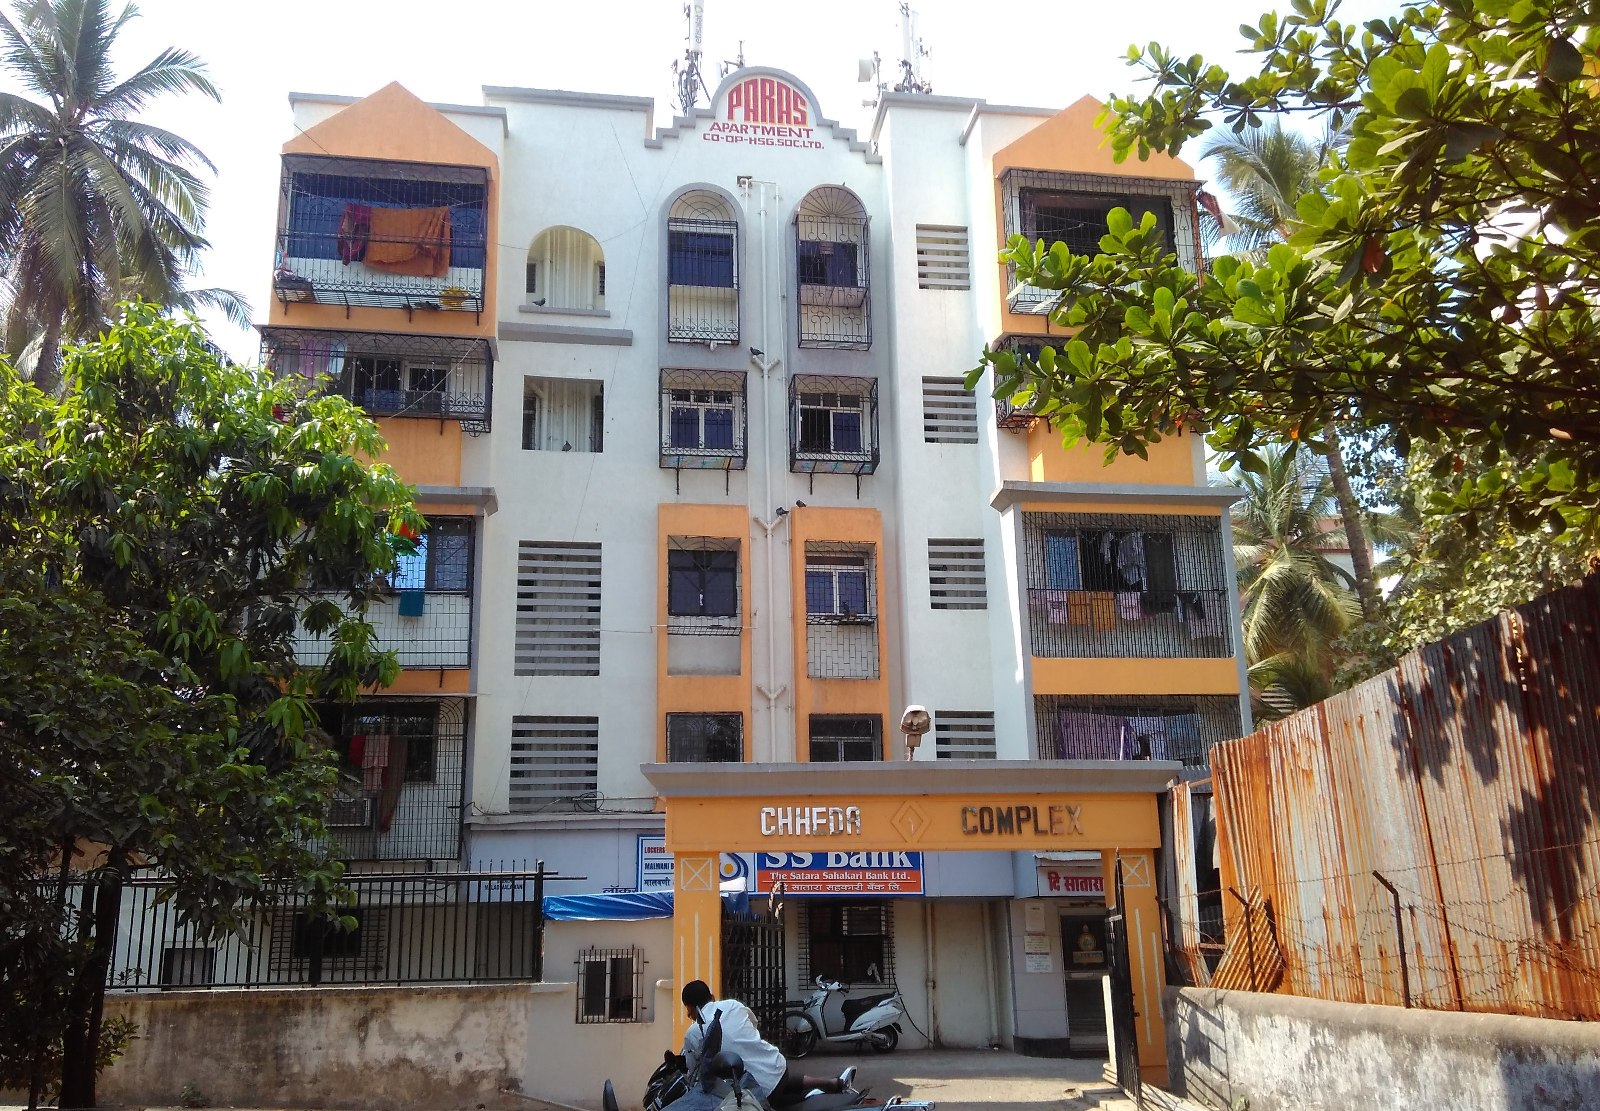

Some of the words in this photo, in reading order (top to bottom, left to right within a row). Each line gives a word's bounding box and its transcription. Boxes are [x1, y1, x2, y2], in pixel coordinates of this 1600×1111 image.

[727, 78, 807, 126] PARAS
[709, 121, 814, 139] APARTMENT
[760, 806, 862, 836] CHHEDA
[961, 805, 1084, 836] COMPLEX
[769, 871, 788, 881] The
[789, 871, 820, 881] Satara
[822, 871, 863, 881] Sahakari
[865, 871, 888, 881] Bank
[891, 871, 911, 881] Ltd.
[791, 883, 823, 892] सातारा
[826, 882, 864, 893] सहकारी
